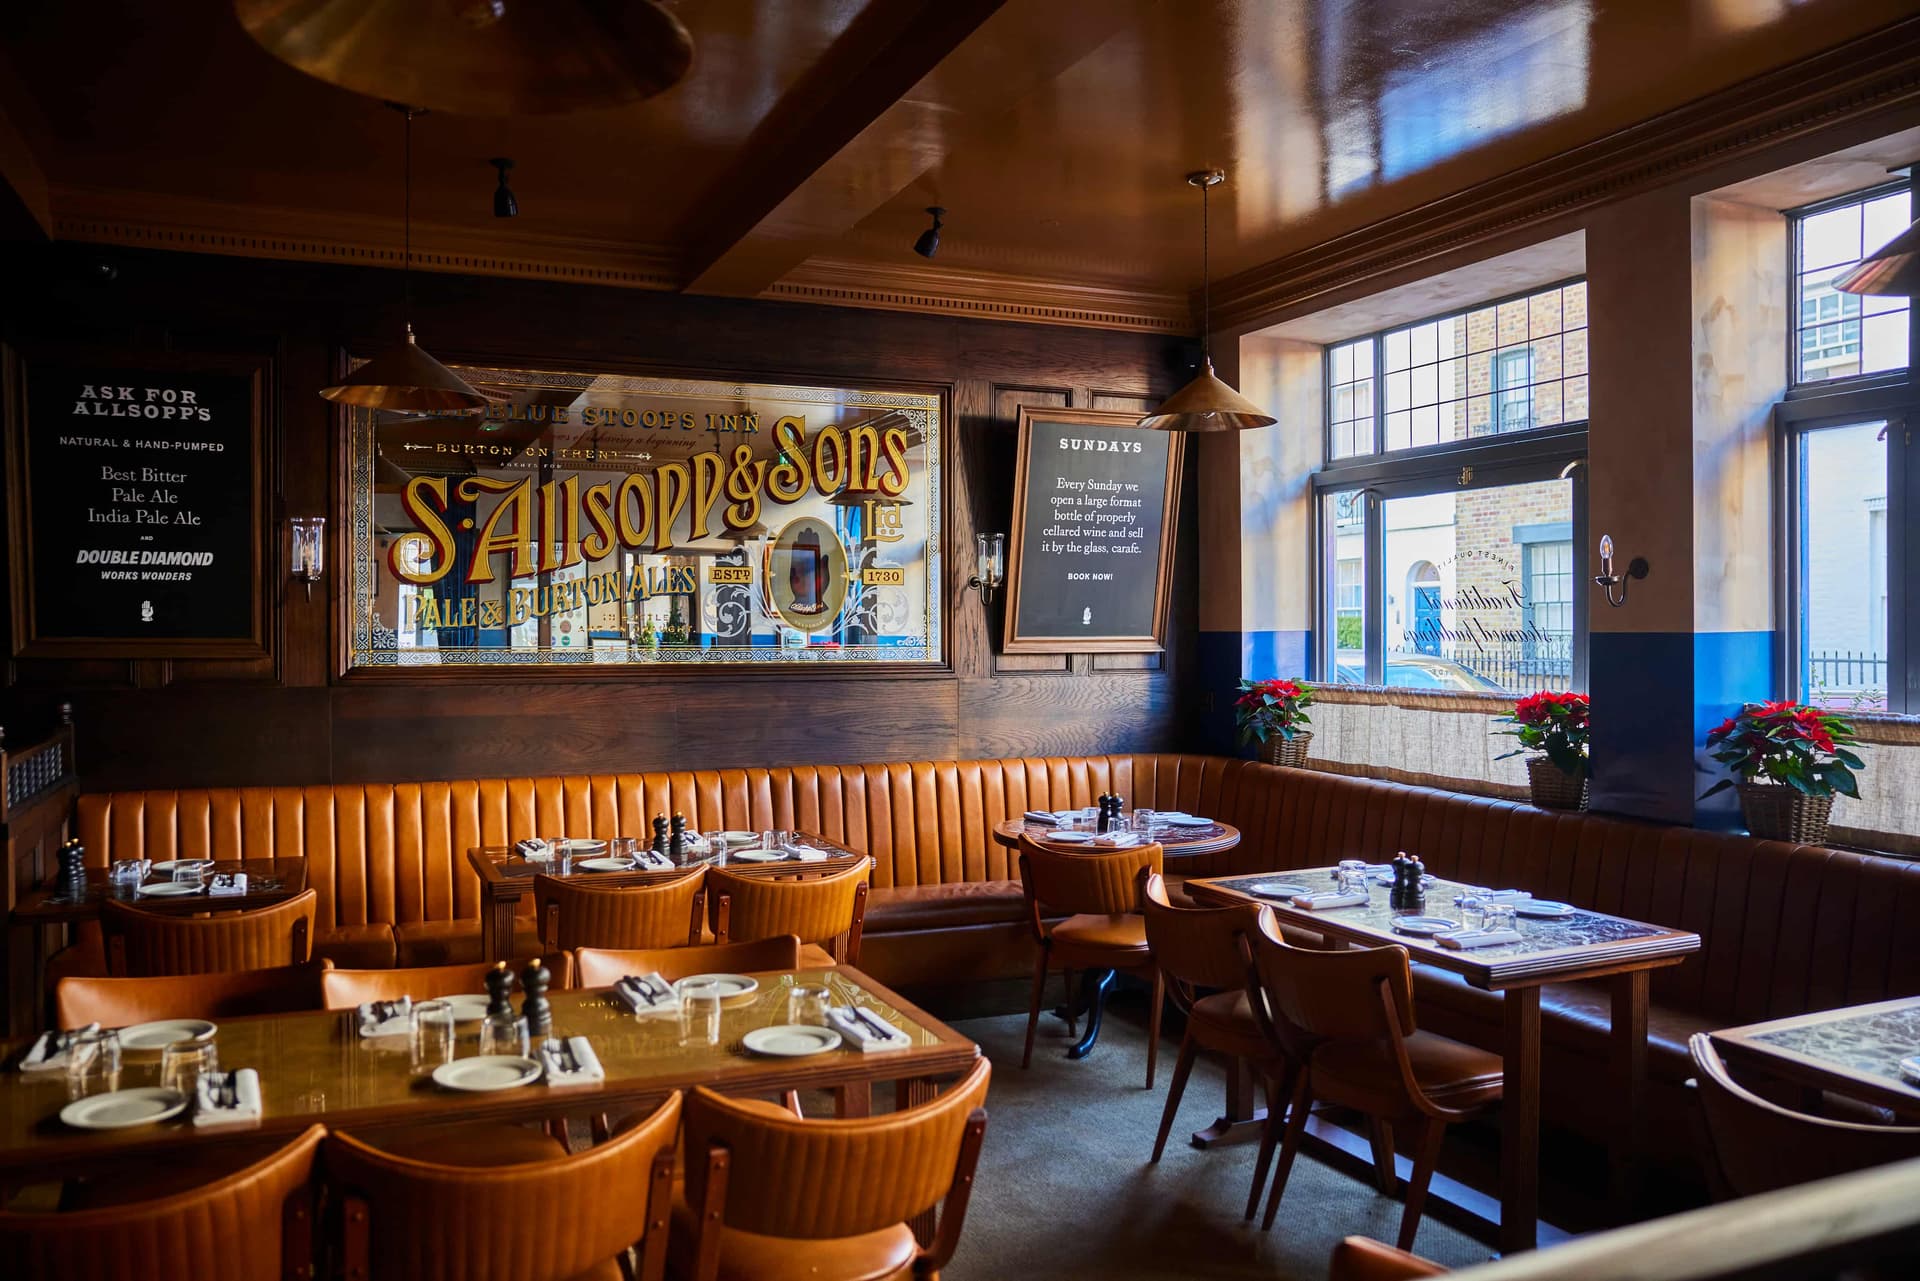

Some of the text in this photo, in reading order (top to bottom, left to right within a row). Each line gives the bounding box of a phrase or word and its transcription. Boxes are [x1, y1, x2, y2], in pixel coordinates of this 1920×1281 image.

[80, 385, 198, 404] ASK FOR
[72, 402, 212, 422] ALLSOPP'S
[486, 402, 570, 422] BLUE
[584, 406, 696, 431] STOOPS
[705, 412, 760, 433] INN
[59, 436, 225, 452] NATURAL & HAND-PUMPED
[436, 443, 618, 460] BURTON ON TRENT
[1059, 438, 1142, 453] SUNDAYS
[100, 466, 188, 484] Best Bitter
[1056, 477, 1139, 493] Every Sunday we
[111, 487, 179, 505] Pale Ale
[1050, 495, 1142, 508] open a large format
[88, 507, 202, 526] India Pale Ale
[1054, 510, 1136, 525] bottle of properly
[1042, 525, 1143, 538] cellared wine and sell
[1041, 541, 1142, 555] it by the glass, carafe.
[76, 549, 214, 567] DOUBLE DIAMOND
[100, 570, 192, 582] WORKS WONDERS
[868, 571, 900, 582] 1730
[1067, 572, 1113, 581] BOOK NOW!
[403, 564, 697, 632] PALE & BURTON ALES
